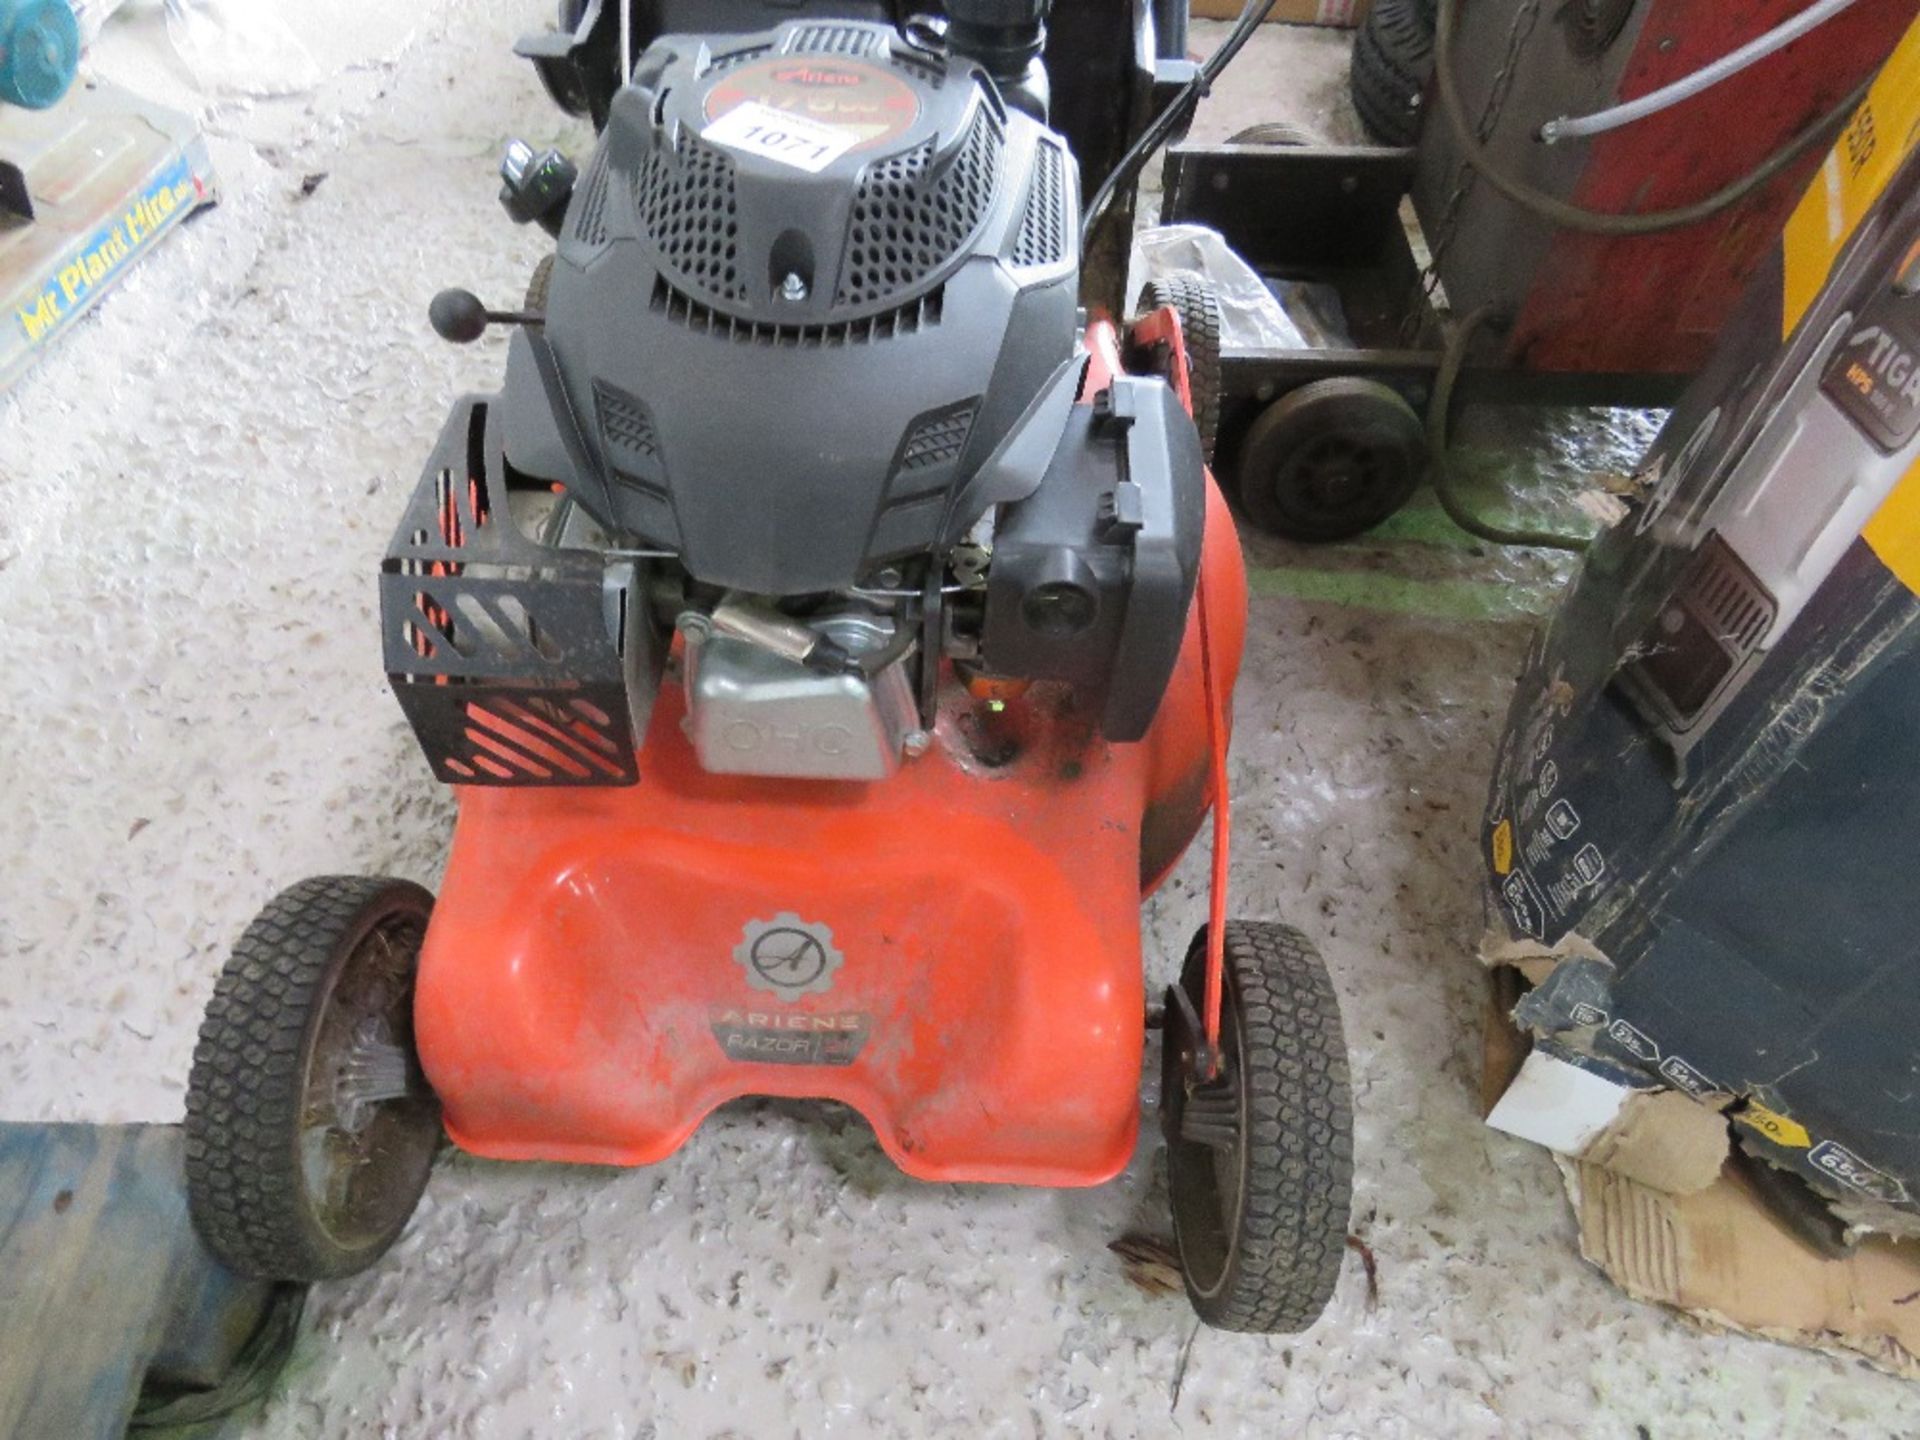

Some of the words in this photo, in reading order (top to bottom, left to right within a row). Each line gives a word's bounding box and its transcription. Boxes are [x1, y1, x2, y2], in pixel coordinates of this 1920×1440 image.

[742, 124, 832, 160] 1071
[17, 291, 62, 342] Mr
[58, 226, 128, 304] Plant
[125, 186, 177, 244] Hire
[721, 718, 852, 755] OHC
[721, 1009, 860, 1029] ARIENS
[726, 1033, 810, 1053] RAZOR
[1819, 1153, 1868, 1186] 650
